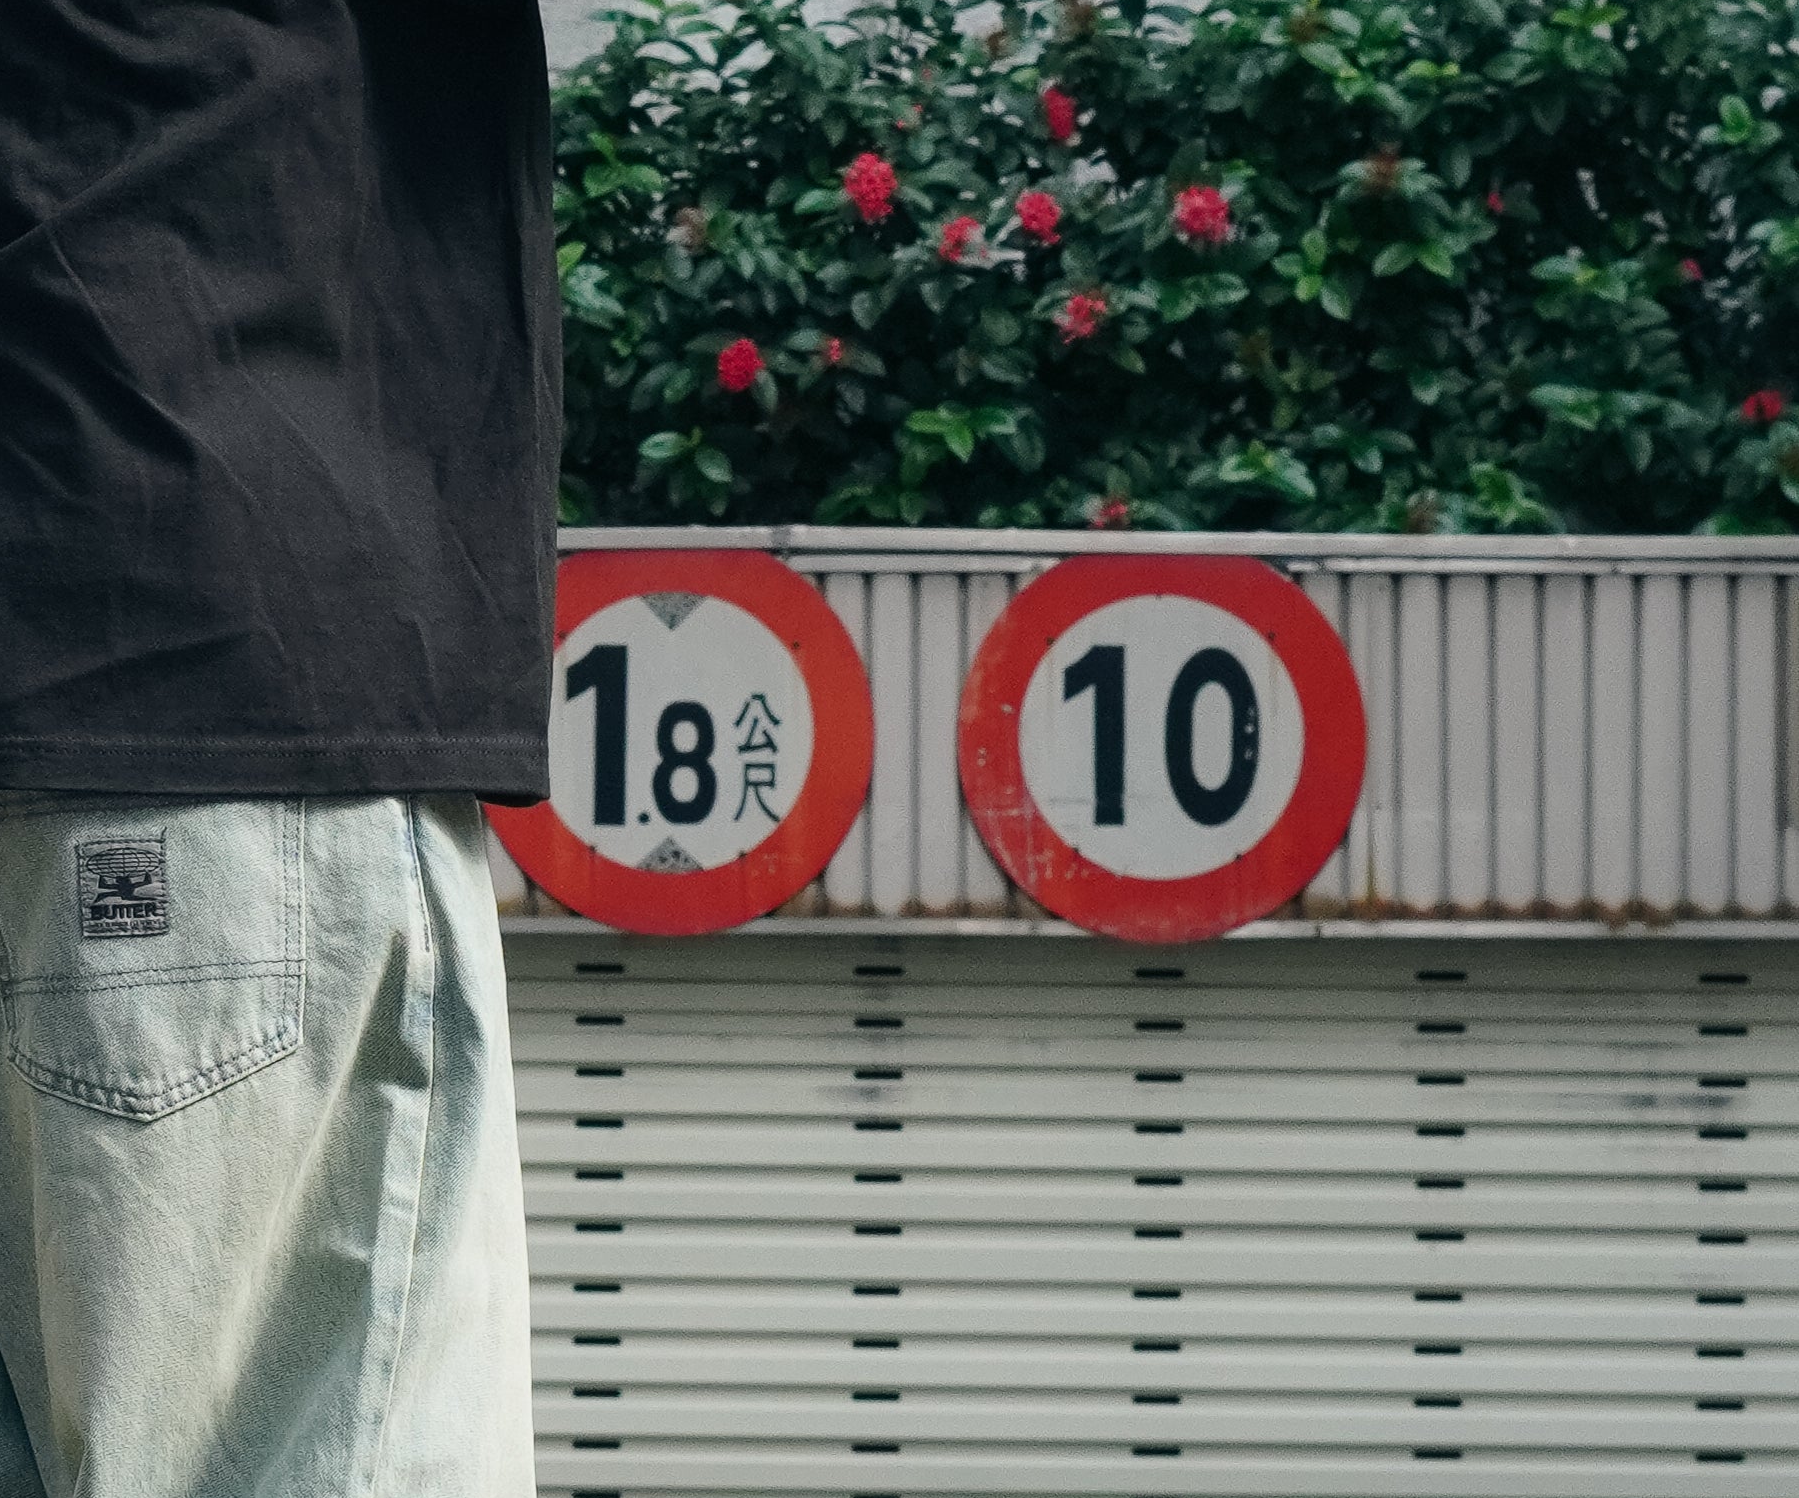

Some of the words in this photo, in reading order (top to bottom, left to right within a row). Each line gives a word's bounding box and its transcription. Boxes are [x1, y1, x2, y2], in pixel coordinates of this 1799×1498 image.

[565, 644, 717, 826] 1.8
[733, 692, 782, 822] 公尺
[1063, 644, 1260, 827] 10
[90, 902, 159, 920] BUTTER
